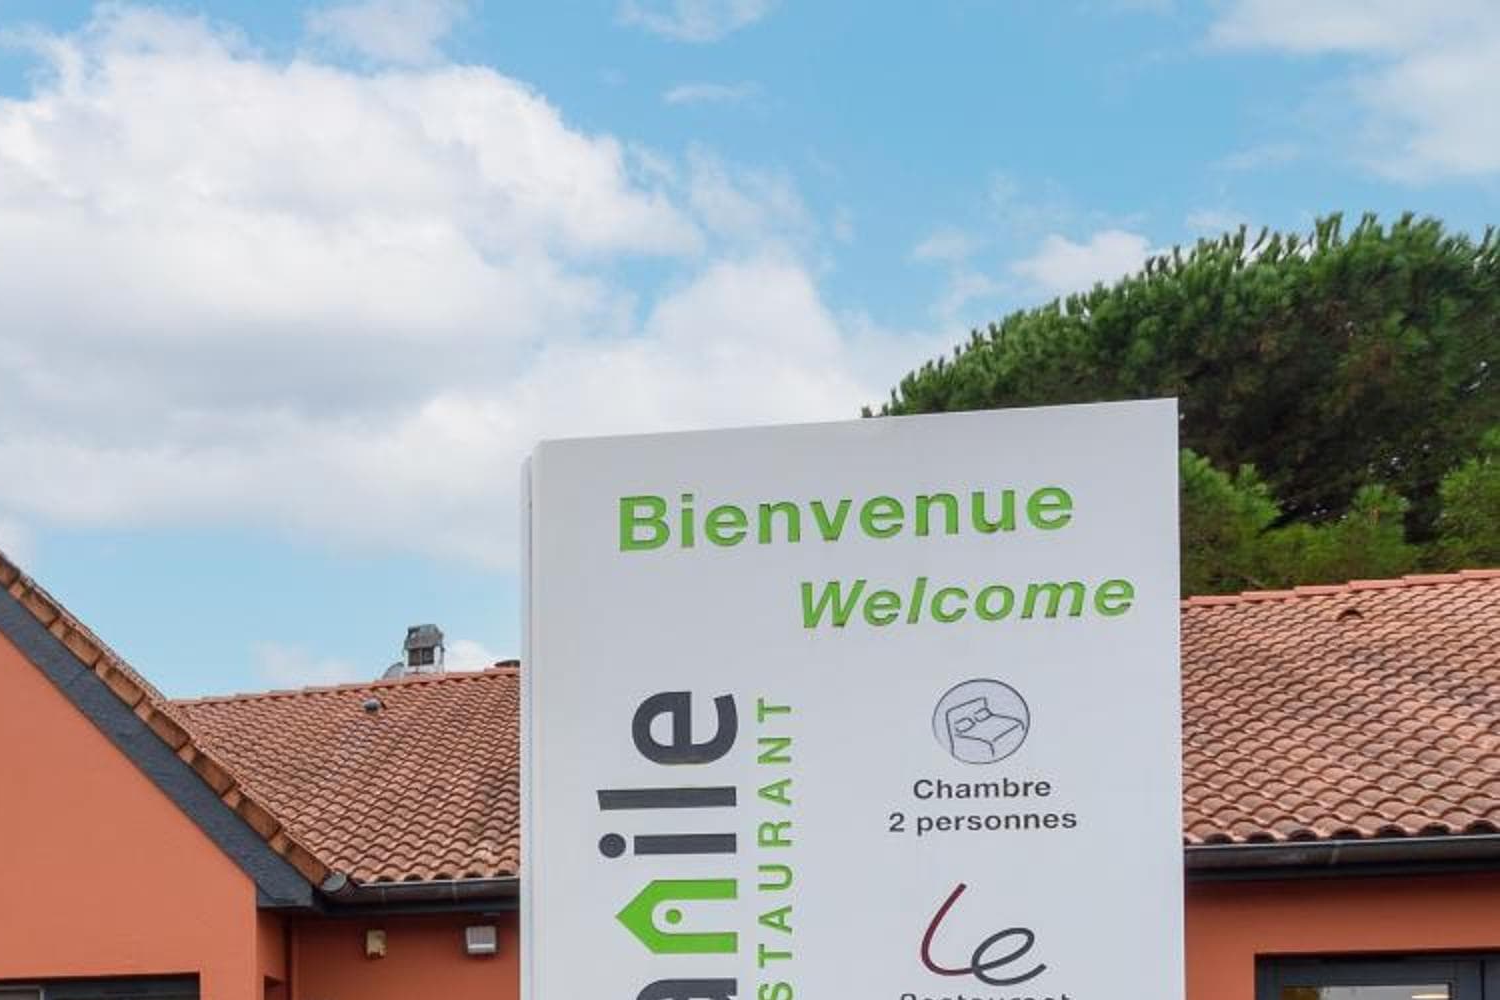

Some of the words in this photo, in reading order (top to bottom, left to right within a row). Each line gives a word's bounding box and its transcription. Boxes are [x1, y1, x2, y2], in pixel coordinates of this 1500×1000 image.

[619, 485, 1073, 552] Bienvenue
[802, 577, 1135, 629] Welcome
[913, 777, 1052, 800] Chambre
[889, 812, 905, 833] 2
[916, 811, 1077, 837] personnes
[920, 882, 1048, 987] Le
